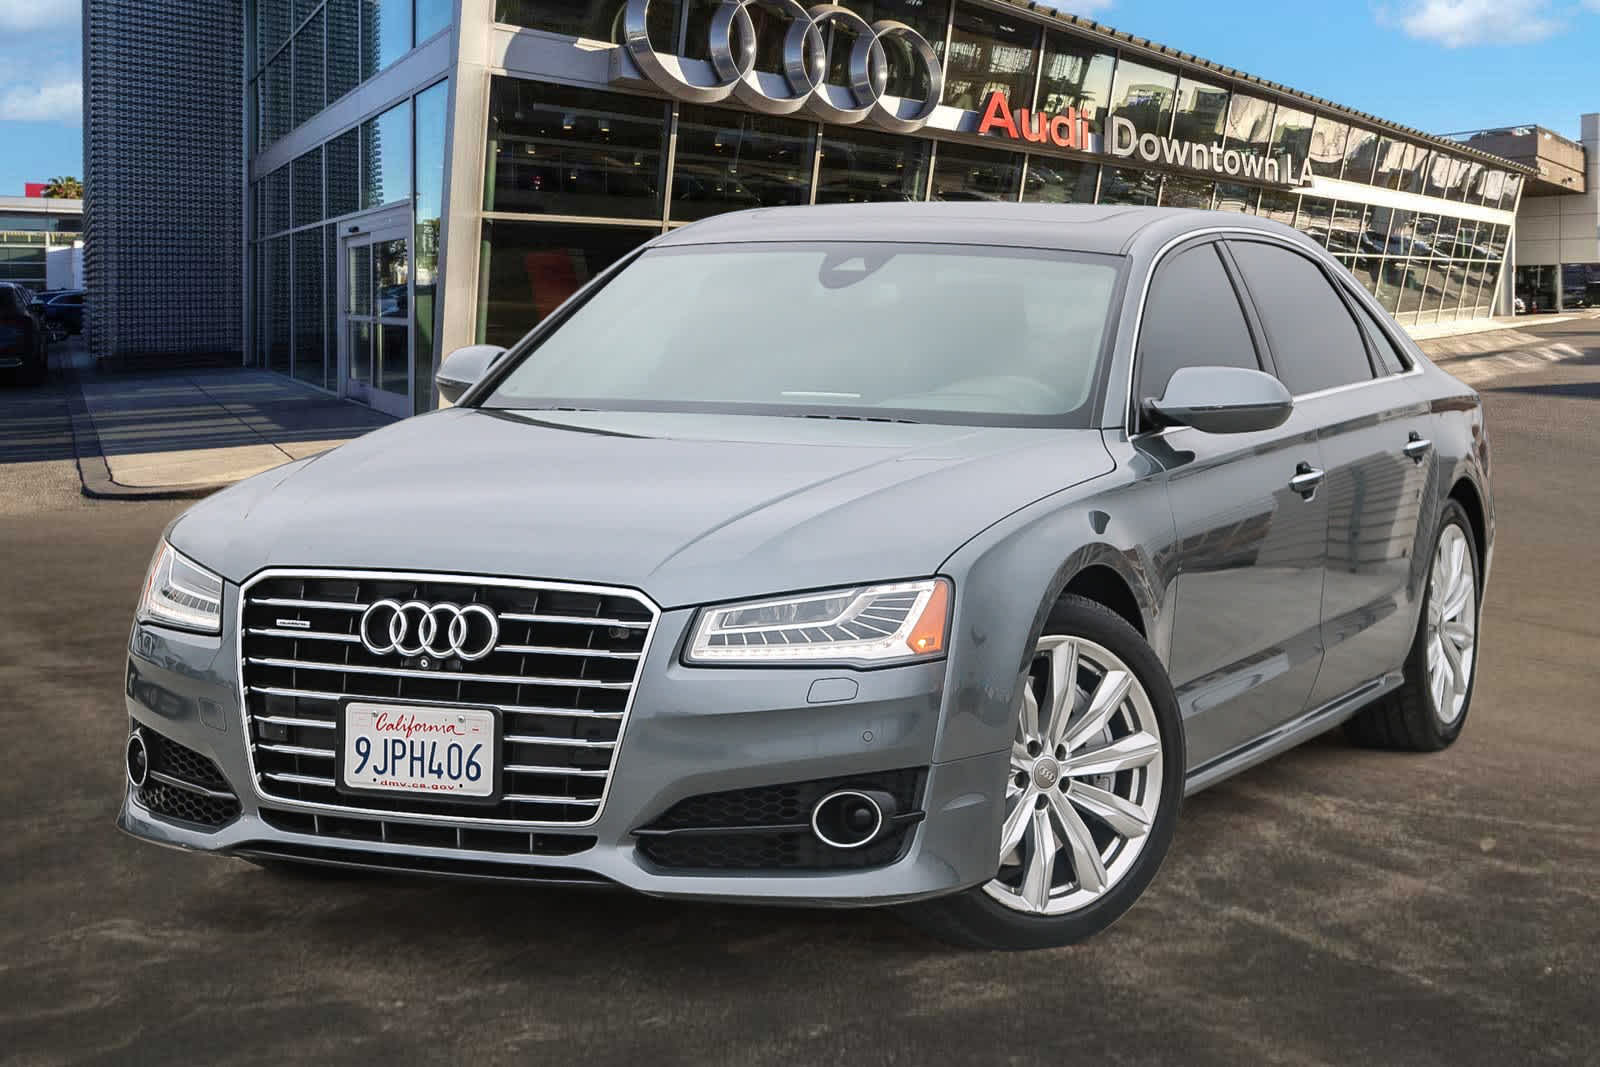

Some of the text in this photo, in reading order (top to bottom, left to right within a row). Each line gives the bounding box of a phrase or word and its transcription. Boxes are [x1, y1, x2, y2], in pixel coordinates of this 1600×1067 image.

[977, 91, 1315, 188] Audi Downtown LA
[376, 712, 465, 738] California
[354, 736, 483, 782] 9JPH406
[380, 780, 455, 791] dmv.ca.gov
